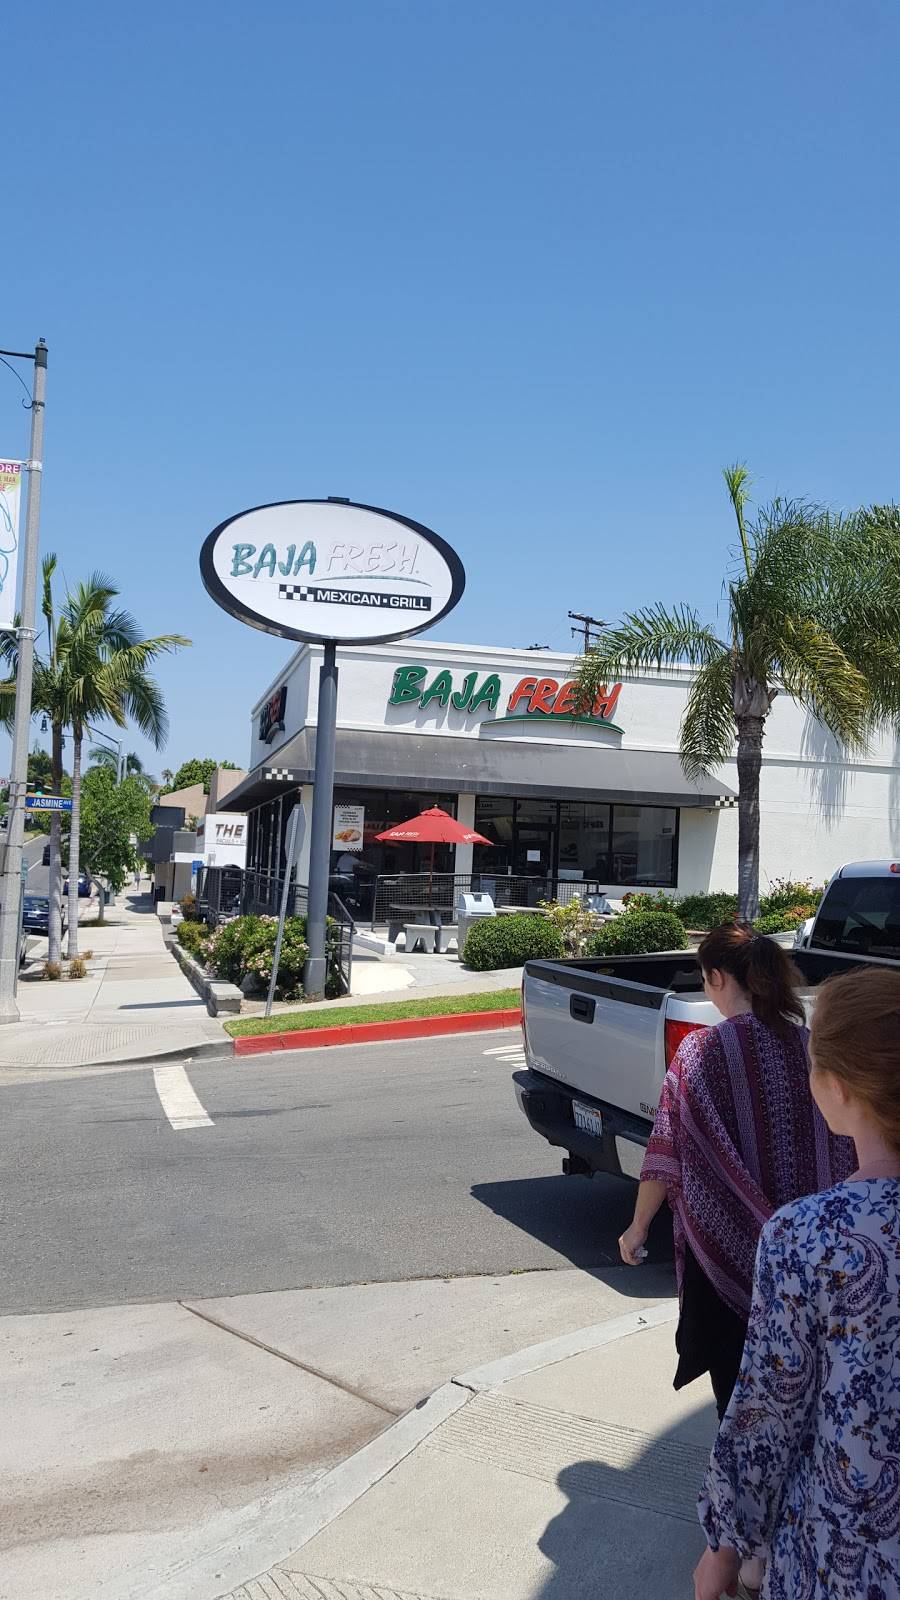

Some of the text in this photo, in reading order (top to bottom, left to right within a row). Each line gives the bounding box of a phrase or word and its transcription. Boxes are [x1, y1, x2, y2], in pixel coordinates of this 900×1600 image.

[230, 540, 420, 579] BAJA FRESH
[317, 590, 428, 609] MEXICAN GRILL
[388, 666, 501, 713] BAJA
[31, 798, 64, 808] JASMINE
[215, 823, 244, 838] THE
